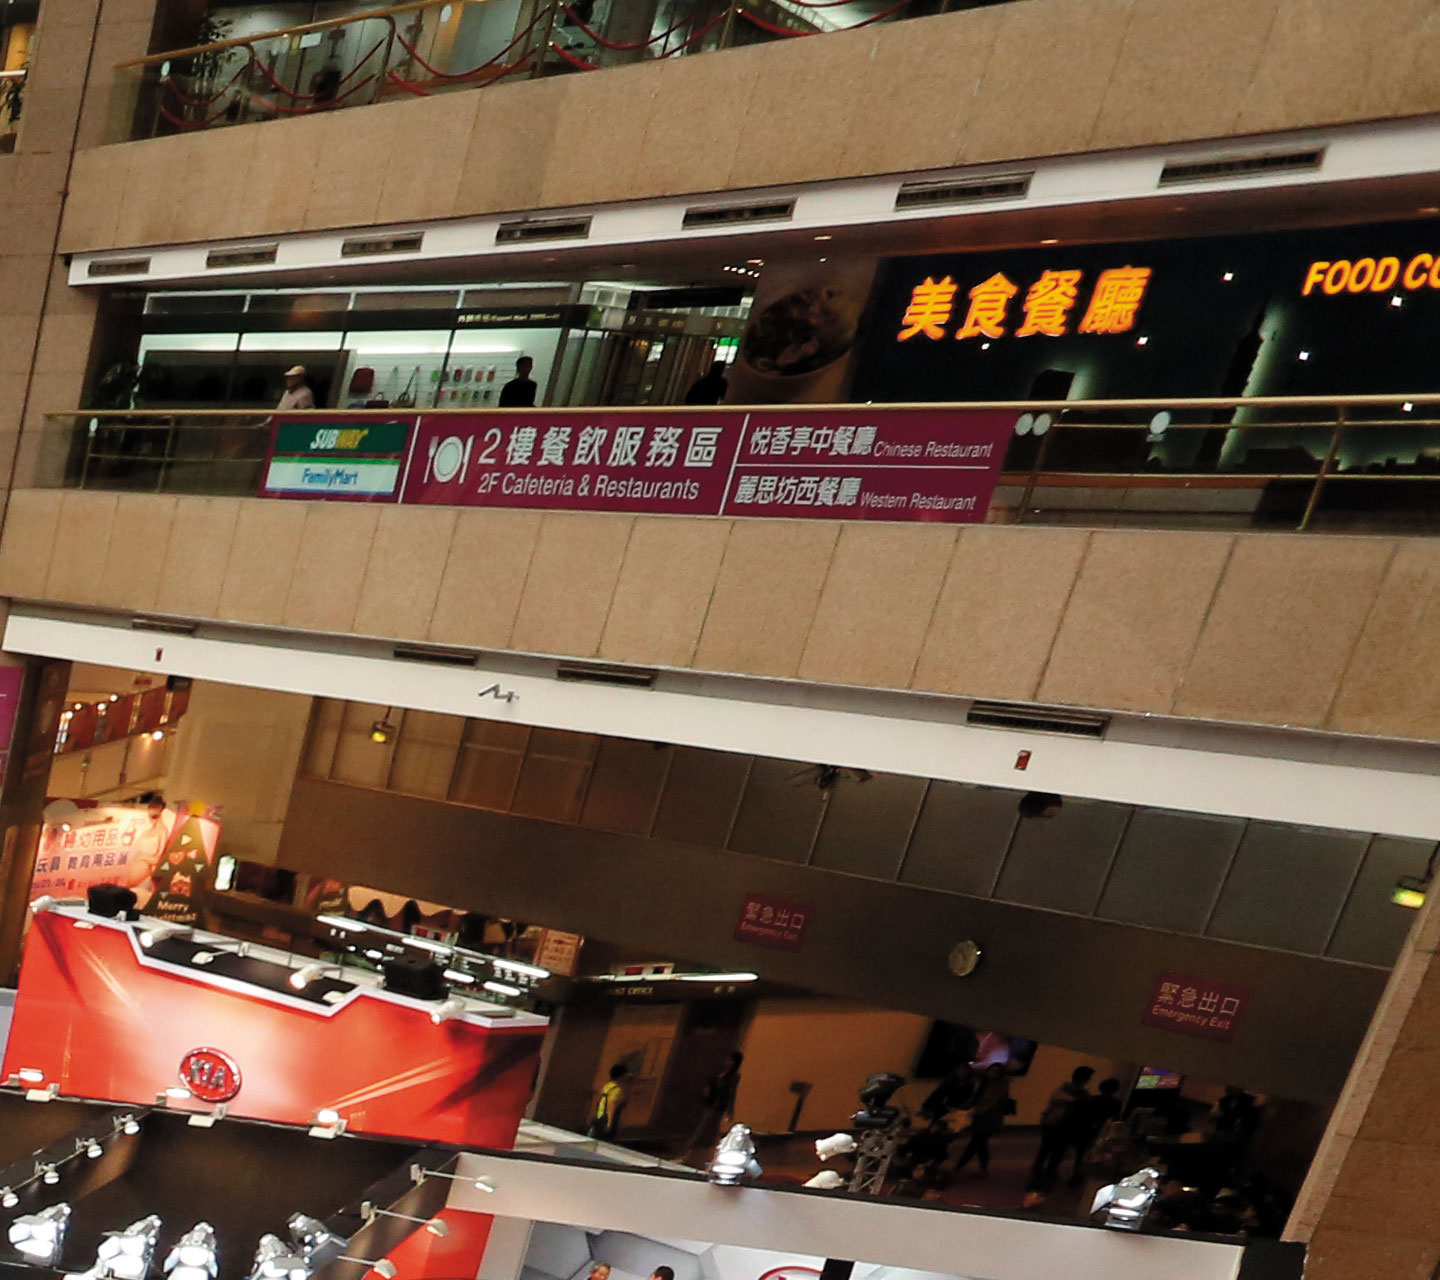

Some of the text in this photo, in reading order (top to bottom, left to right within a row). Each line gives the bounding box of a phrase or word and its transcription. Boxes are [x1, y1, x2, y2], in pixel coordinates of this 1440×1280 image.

[1301, 255, 1400, 297] FOOD
[897, 265, 1152, 341] 美食餐廳
[310, 427, 369, 450] SUBWAY
[478, 426, 723, 470] 2樓餐飲服務區
[874, 441, 994, 460] Chinese Restaurant
[301, 467, 360, 488] FamilyMart
[477, 474, 699, 502] 2F Cafeteria & Restaurants
[860, 492, 977, 511] Western Restaurant
[157, 900, 190, 913] Merry
[743, 902, 805, 929] 緊急出口
[741, 921, 783, 940] Emergency
[1157, 981, 1241, 1017] 緊急出口
[1152, 1005, 1231, 1030] Emergency Exit
[189, 1056, 227, 1092] KIA
